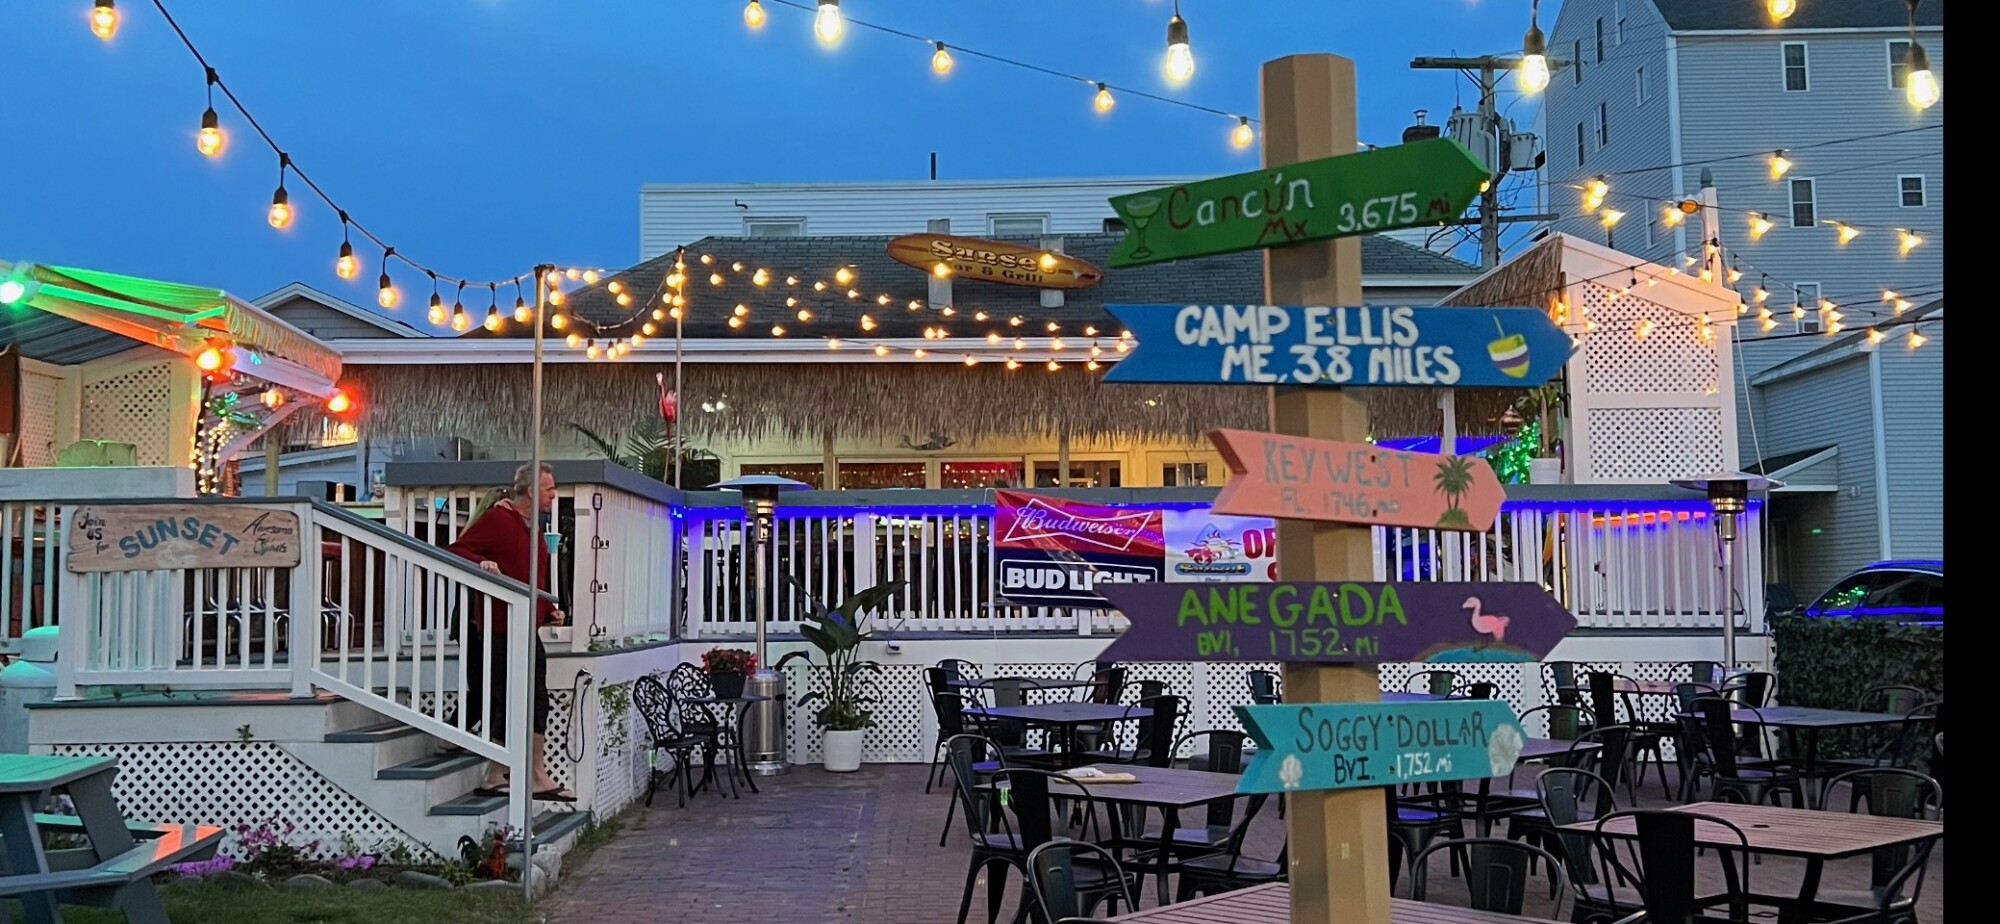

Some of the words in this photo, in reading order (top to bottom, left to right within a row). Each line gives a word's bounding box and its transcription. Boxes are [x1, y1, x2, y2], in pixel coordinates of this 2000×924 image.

[931, 240, 1056, 274] Sunse
[1002, 270, 1043, 282] Grill
[1175, 305, 1290, 346] CAMP
[1306, 307, 1419, 346] ELLIS
[1368, 346, 1461, 385] MILES
[1263, 440, 1316, 484] KEY
[1323, 448, 1414, 489] WEST
[119, 516, 240, 559] SUNSET
[1017, 507, 1137, 536] Budweiser
[1007, 567, 1066, 589] BUD
[1296, 706, 1381, 753] SOGGY
[1397, 711, 1489, 748] DOLLAR
